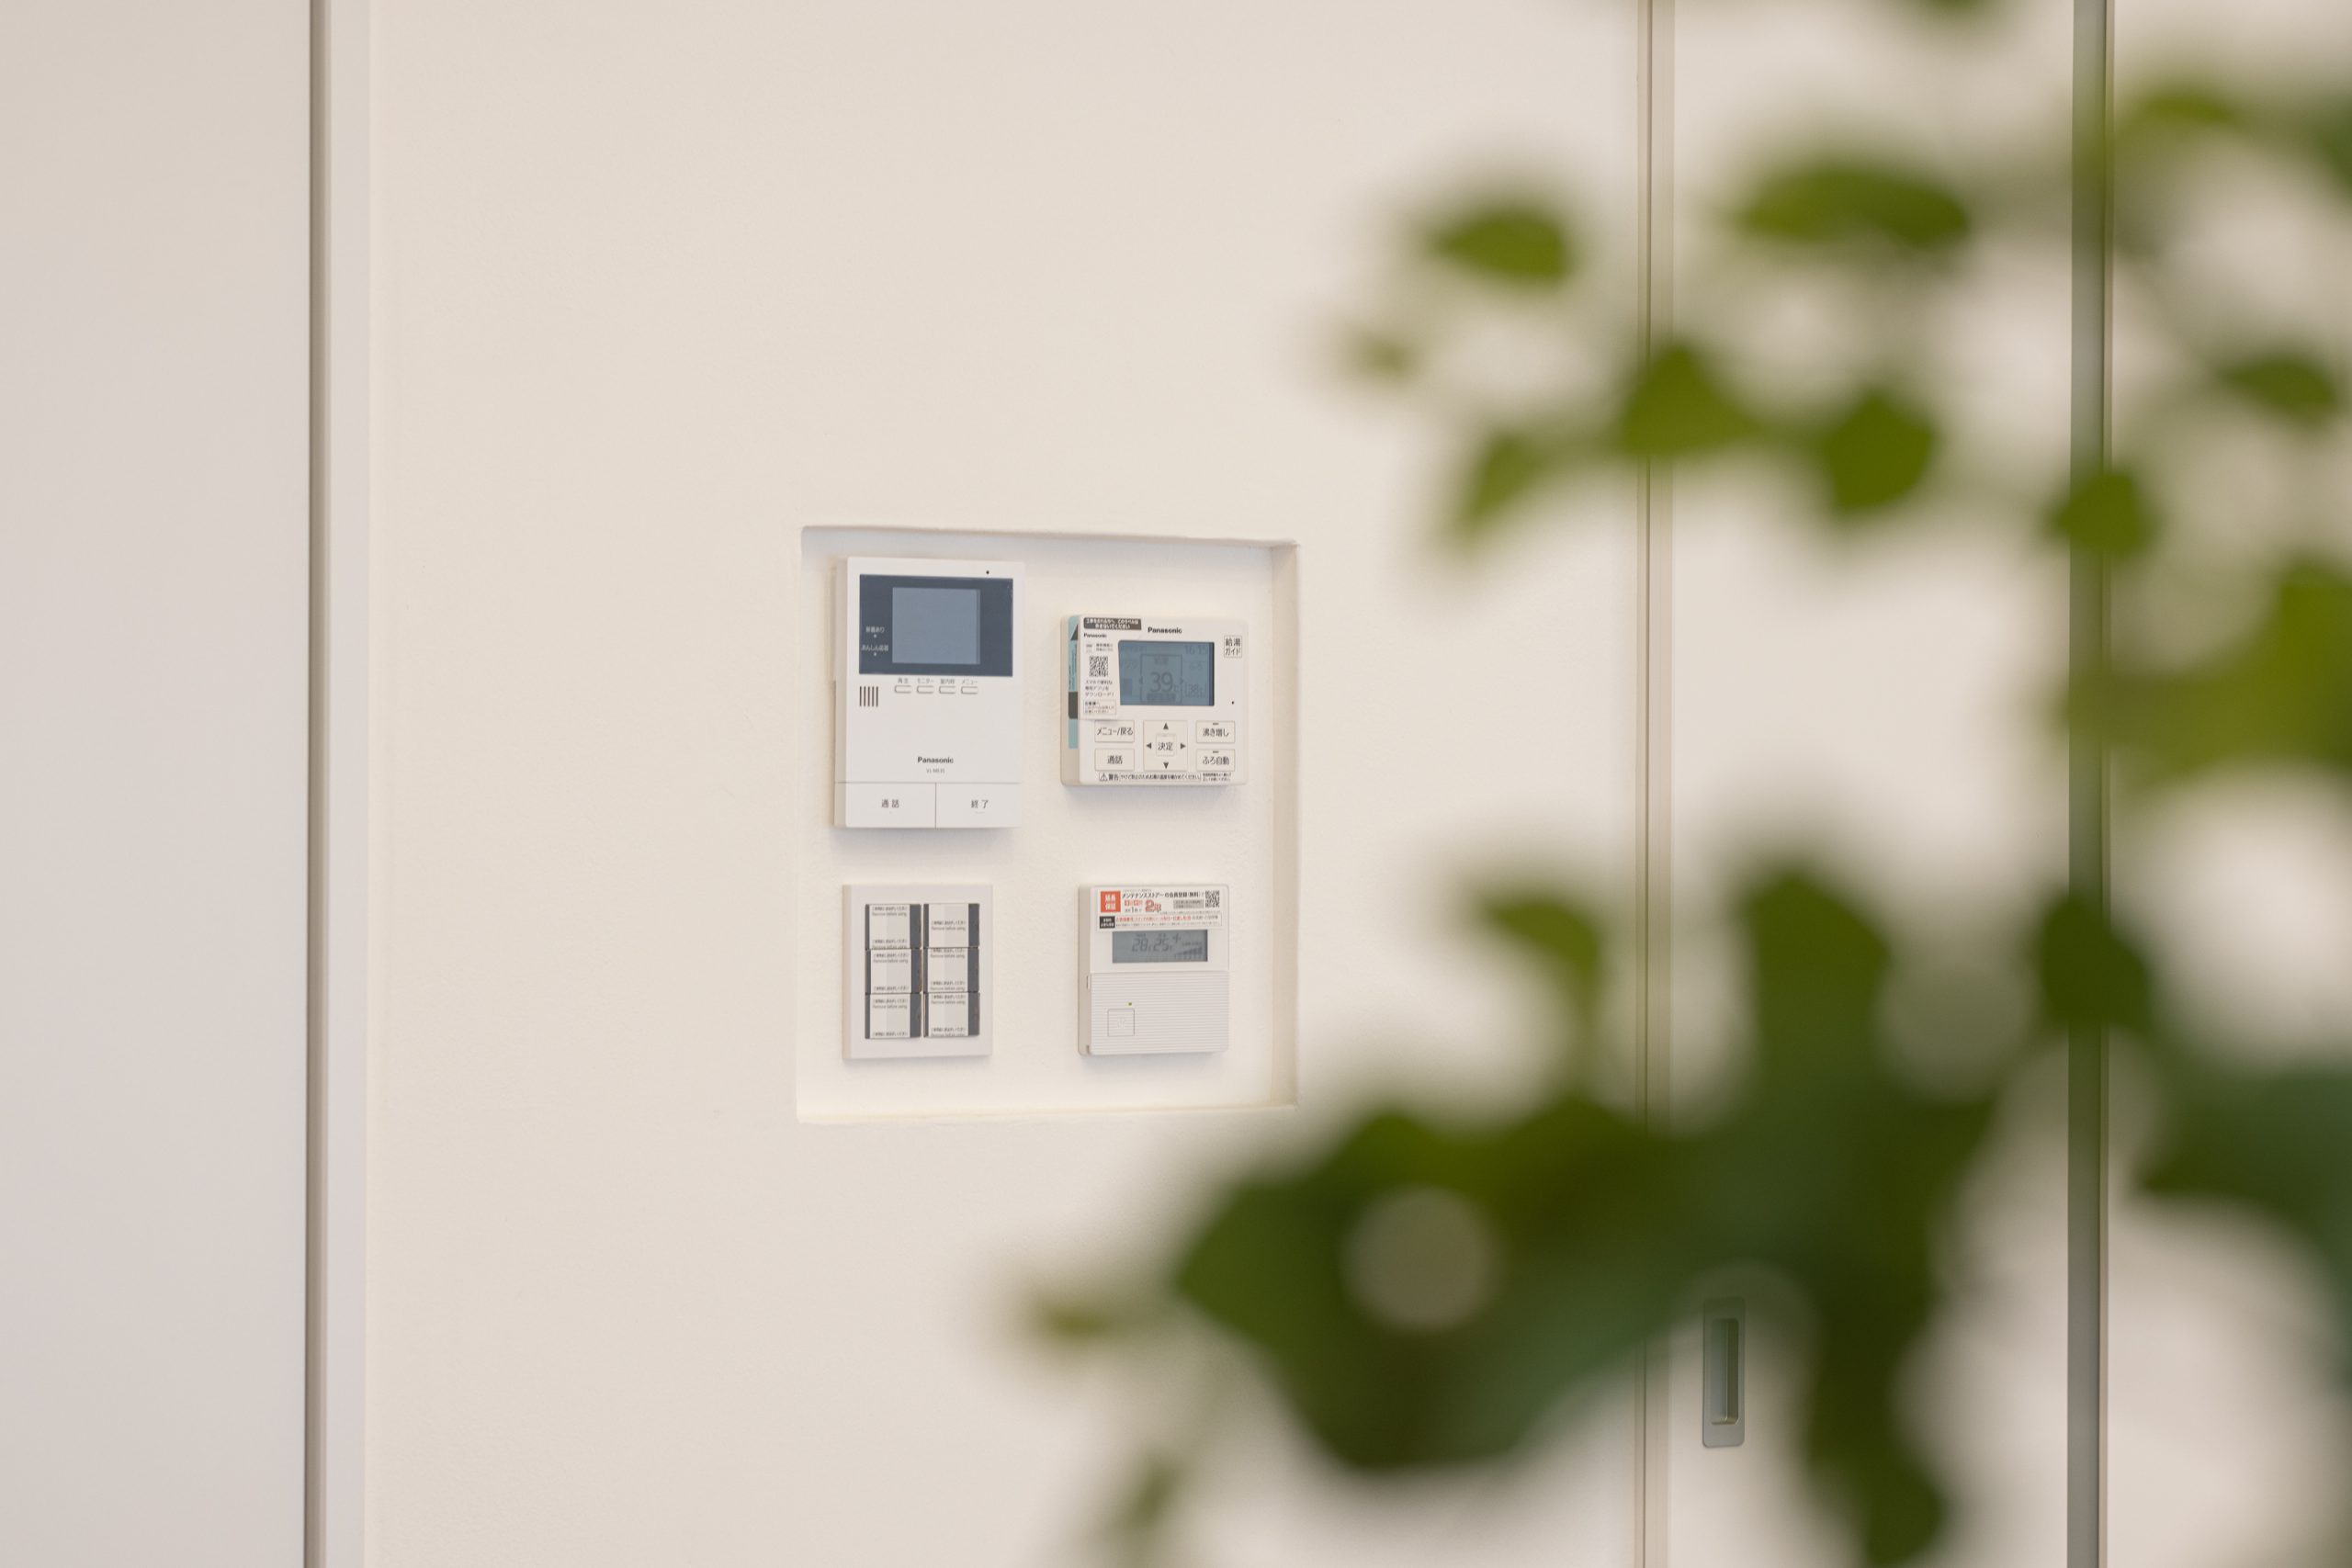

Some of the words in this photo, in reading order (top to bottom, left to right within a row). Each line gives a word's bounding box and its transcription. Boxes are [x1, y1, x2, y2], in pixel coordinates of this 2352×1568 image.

[1225, 637, 1241, 647] 給湯
[1225, 648, 1241, 656] ガイド
[1097, 727, 1134, 736] メニュー/戻る
[1203, 728, 1229, 737] 沸き増し
[1158, 741, 1173, 751] 決定
[1107, 755, 1123, 765] 通話
[1202, 756, 1230, 765] ふろ自動
[881, 799, 899, 808] 通話
[970, 800, 989, 808] 終了
